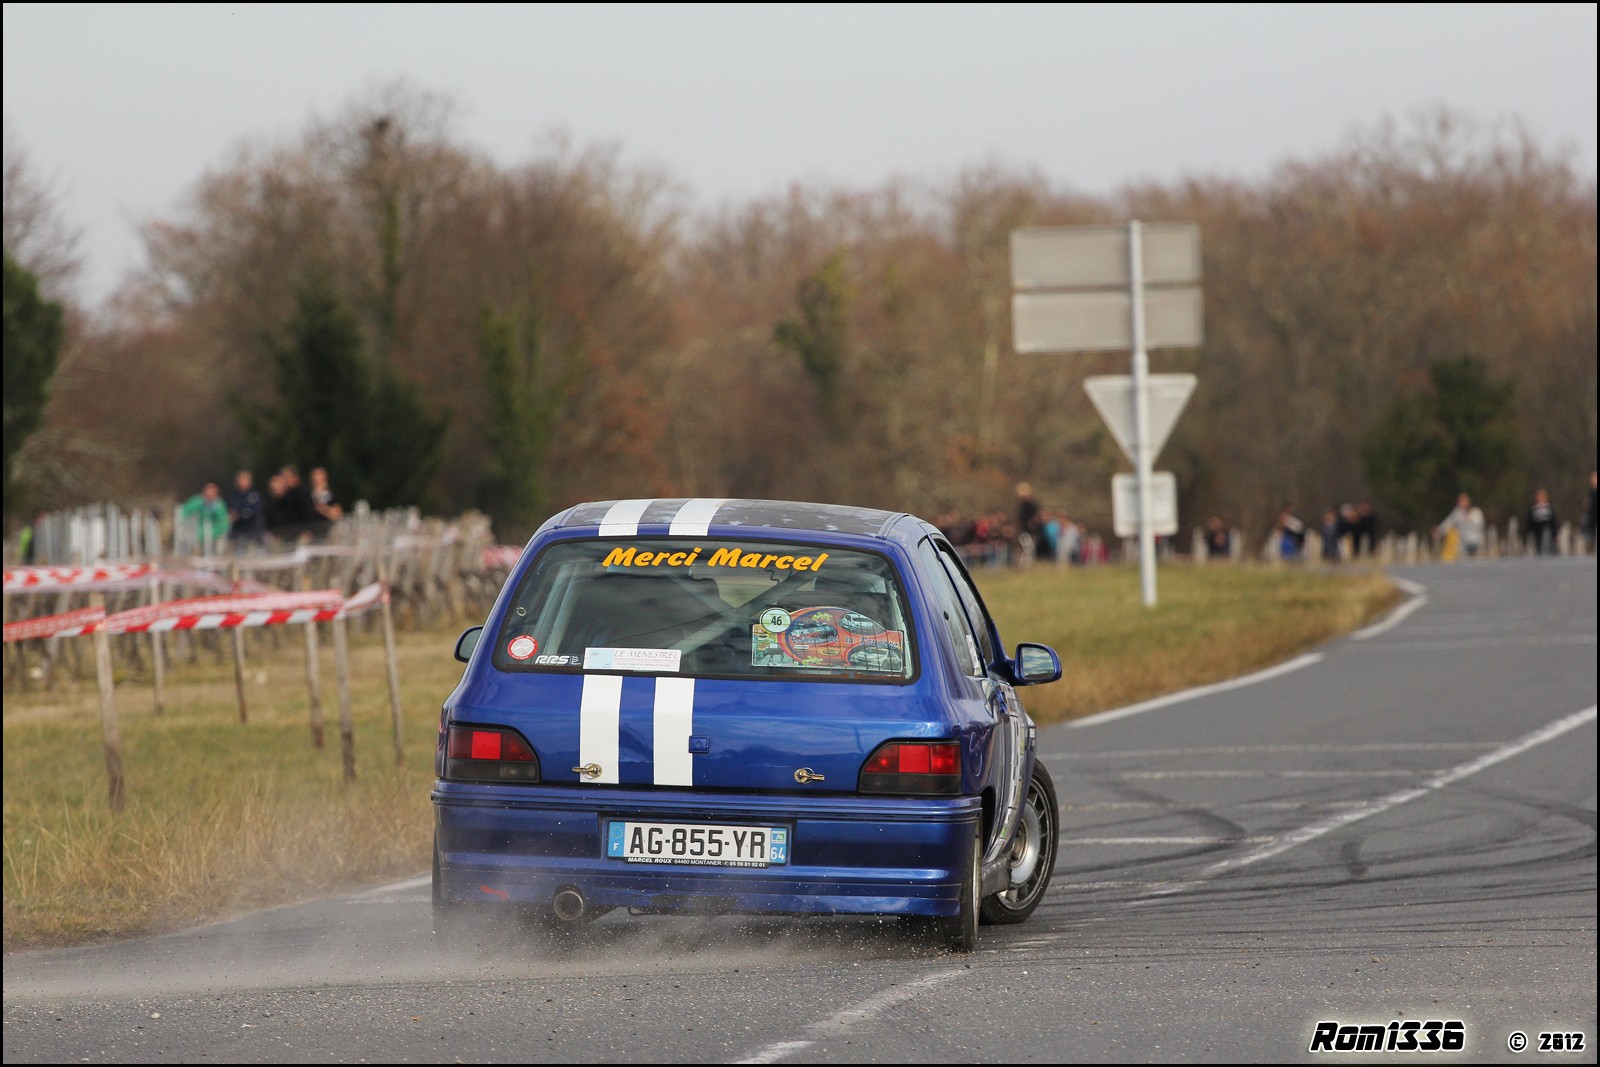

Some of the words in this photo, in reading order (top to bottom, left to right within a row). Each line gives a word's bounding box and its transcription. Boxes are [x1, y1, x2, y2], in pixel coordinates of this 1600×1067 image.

[602, 547, 702, 567] Merci
[708, 548, 829, 572] Marcel
[770, 615, 782, 626] 46
[535, 655, 570, 664] RRS
[614, 650, 623, 658] LE
[613, 842, 619, 851] F
[629, 826, 766, 859] AG-855-YR
[770, 846, 785, 860] 64
